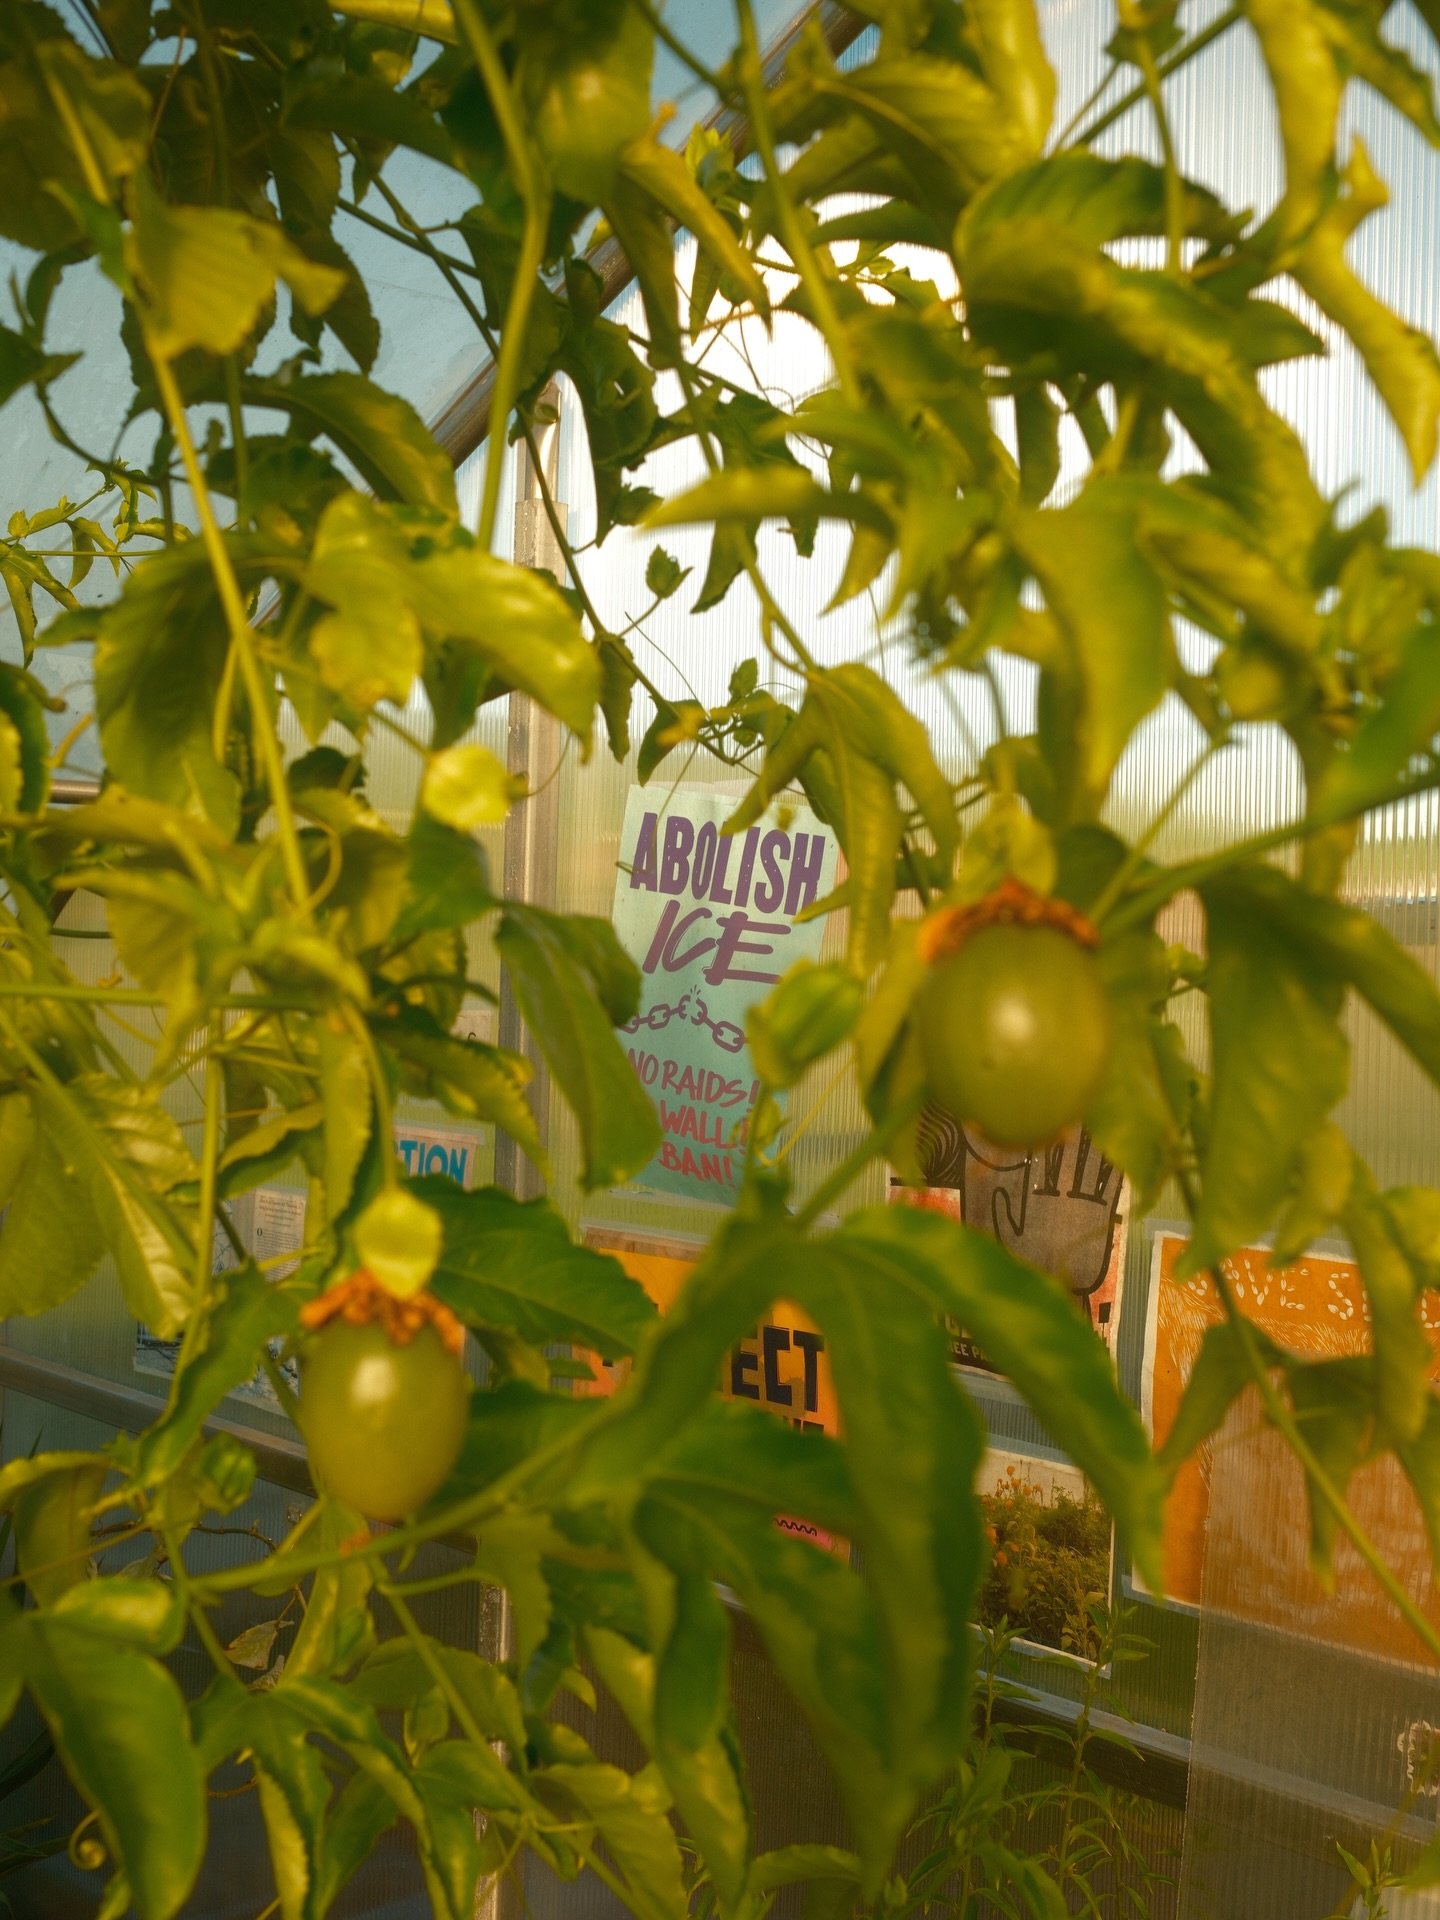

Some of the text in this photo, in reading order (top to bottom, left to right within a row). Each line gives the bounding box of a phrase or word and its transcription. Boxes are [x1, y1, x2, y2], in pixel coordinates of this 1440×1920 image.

[630, 811, 826, 916] ABOLISH
[642, 899, 792, 986] ICE
[627, 1047, 760, 1113] NO RAIDS!
[395, 1139, 468, 1185] TION
[657, 1140, 737, 1189] BAN!
[728, 1323, 826, 1414] ECT
